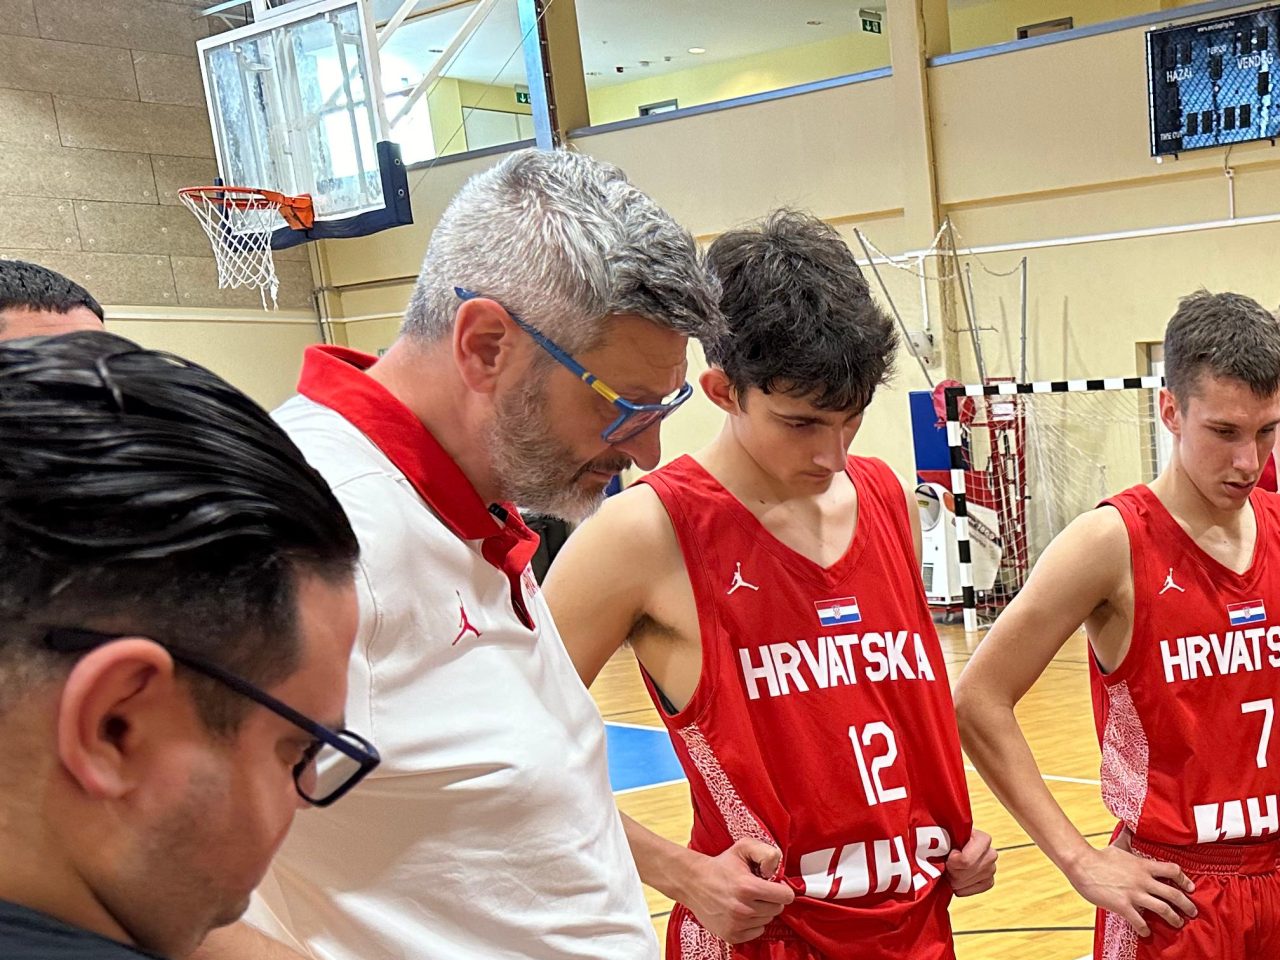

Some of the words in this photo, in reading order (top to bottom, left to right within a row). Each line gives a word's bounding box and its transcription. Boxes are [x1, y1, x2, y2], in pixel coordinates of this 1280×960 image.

[739, 630, 936, 700] HRVATSKA
[848, 721, 908, 806] 12
[1241, 698, 1275, 768] 7
